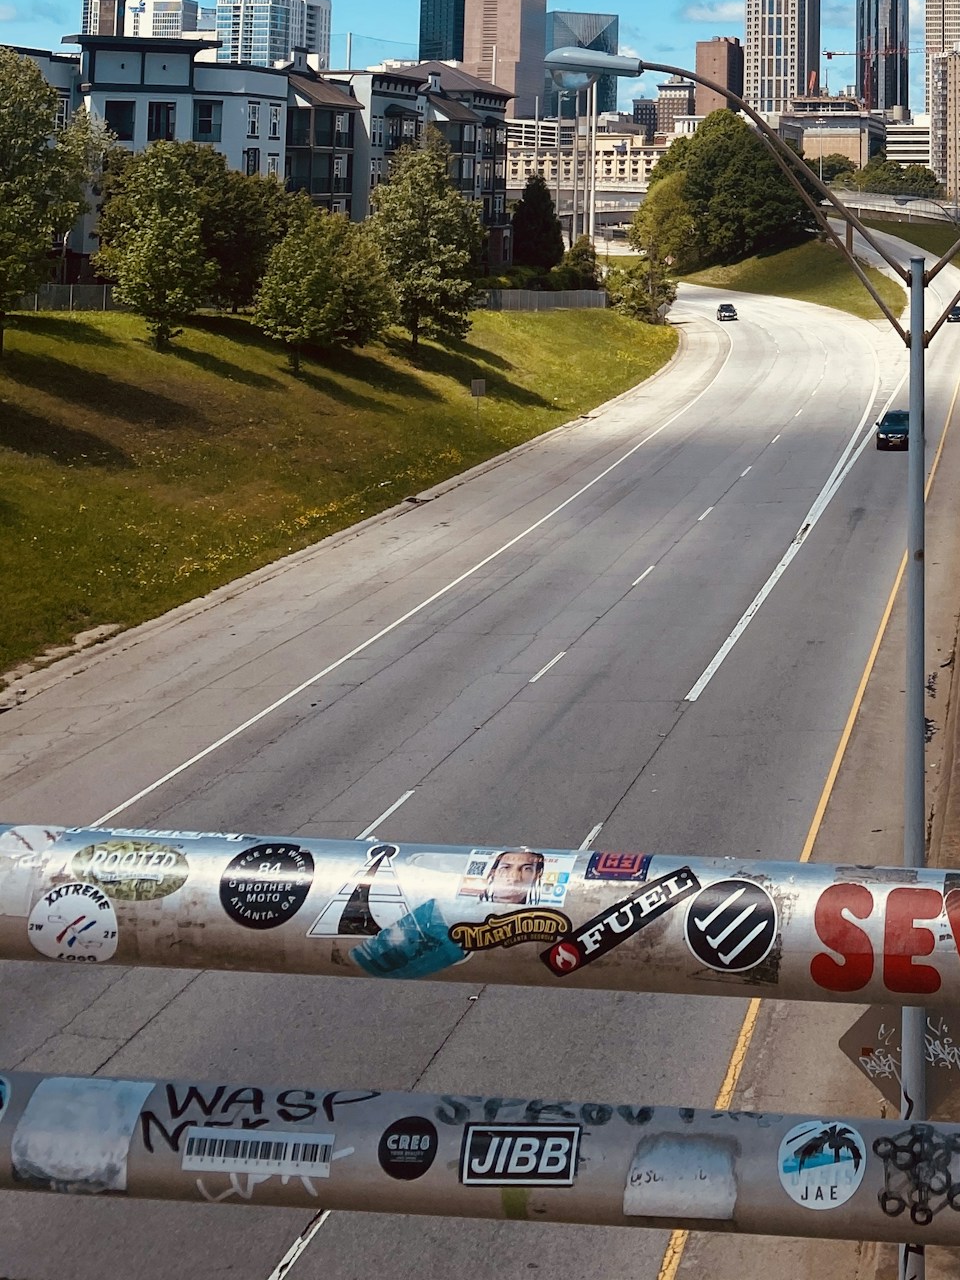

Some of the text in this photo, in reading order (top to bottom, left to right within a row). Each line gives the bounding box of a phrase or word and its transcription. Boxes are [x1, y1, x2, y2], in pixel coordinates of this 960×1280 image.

[84, 850, 177, 876] ROOTED
[258, 862, 282, 875] 84
[238, 882, 292, 892] BROTHER
[45, 883, 111, 911] XXTREME
[246, 893, 280, 903] MOTO
[281, 895, 296, 910] GA
[28, 923, 44, 931] 2W
[452, 912, 568, 948] MARY TODD
[103, 931, 117, 939] 2F
[471, 1137, 570, 1174] JIBB
[801, 1185, 838, 1201] JAE
